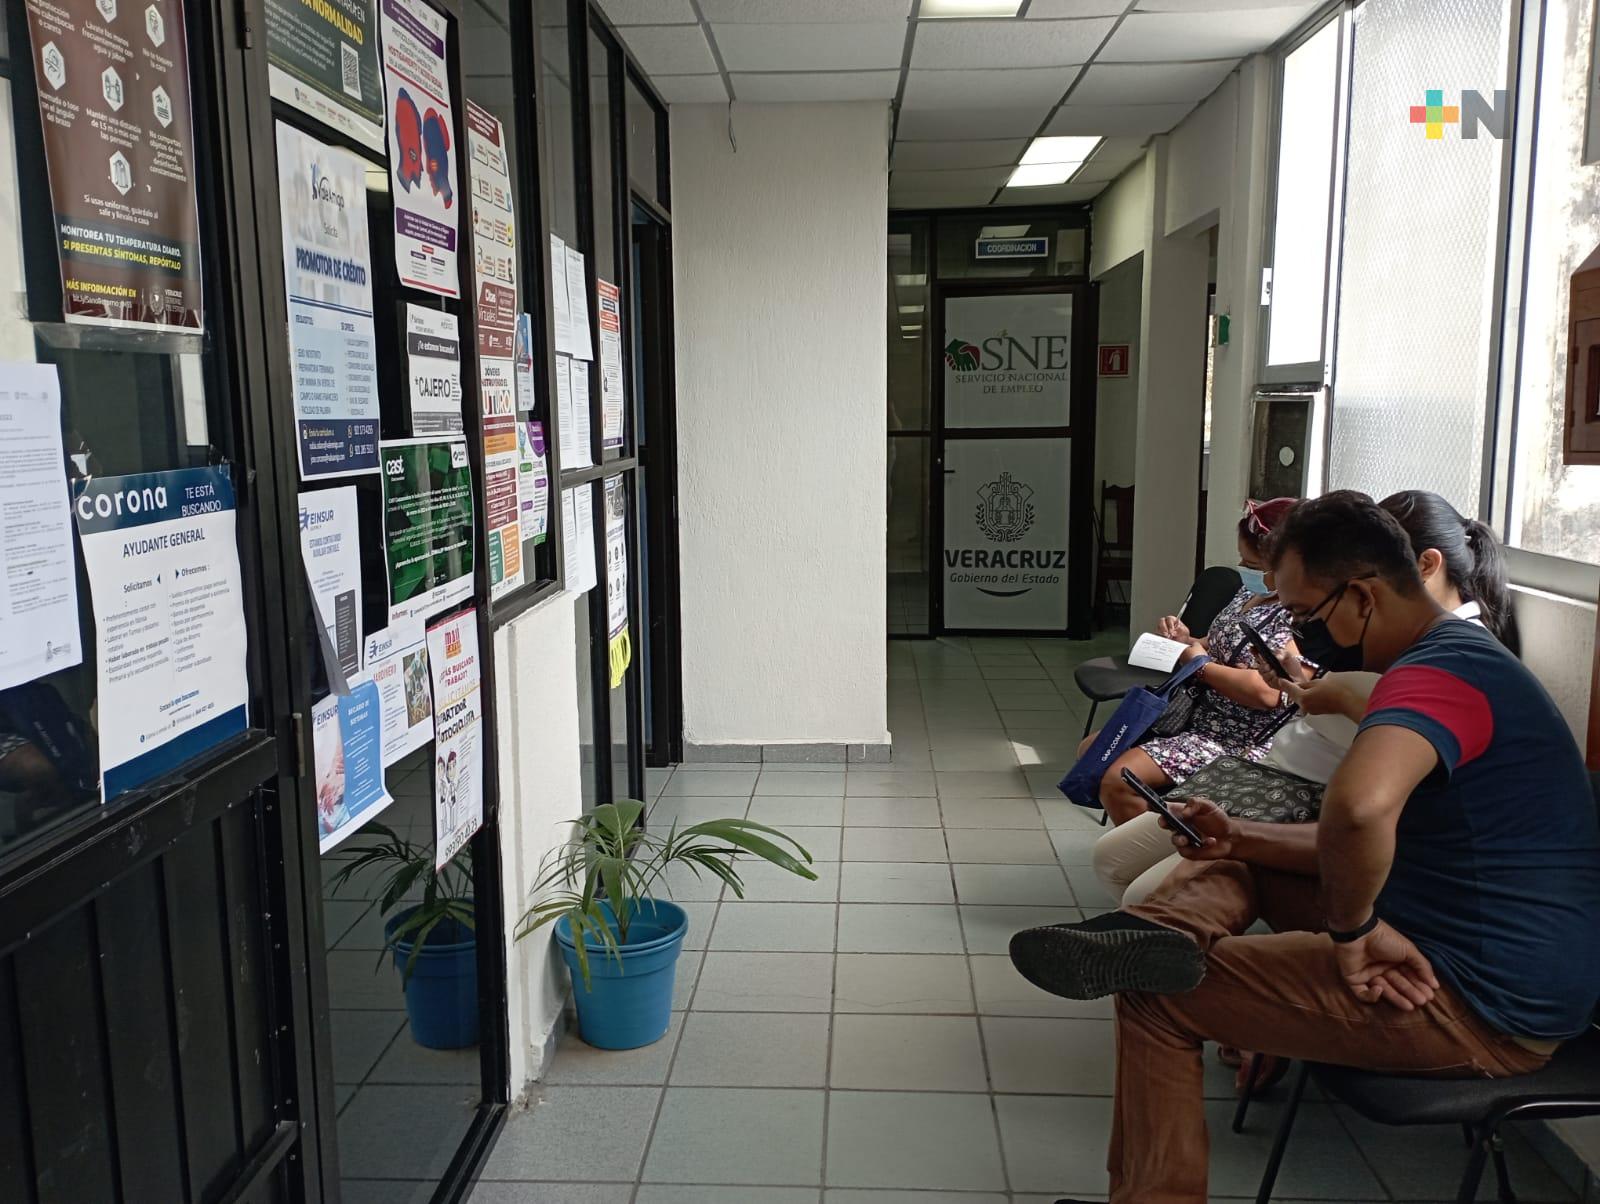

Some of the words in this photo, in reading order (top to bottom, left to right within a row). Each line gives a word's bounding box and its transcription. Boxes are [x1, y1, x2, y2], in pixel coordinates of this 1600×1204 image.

[61, 223, 103, 241] MONITOREA
[105, 232, 115, 244] TU
[116, 235, 161, 254] TEMPERATURA
[987, 243, 1037, 253] COORDINACION
[63, 239, 70, 249] SI
[70, 241, 113, 259] PRESENTAS
[114, 247, 149, 265] SÍNTOMAS,
[149, 256, 181, 271] REPÓRTALO
[295, 247, 333, 278] PROMOTOR
[333, 261, 343, 279] DE
[343, 257, 366, 287] CRÉDITO
[66, 277, 79, 291] MÁS
[80, 280, 128, 298] INFORMACIÓN
[129, 288, 137, 298] EN
[982, 335, 1068, 371] SNE
[955, 373, 1005, 383] SERVICIO
[1008, 372, 1067, 382] NACIONAL
[983, 385, 998, 394] DE
[1000, 384, 1043, 393] EMPLEO
[482, 389, 511, 415] UTURO
[185, 487, 194, 499] TE
[195, 481, 215, 497] ESTÁ
[77, 486, 168, 520] corona
[182, 499, 222, 517] BUSCANDO
[310, 509, 335, 526] EINSUR
[122, 535, 168, 558] AYUDANTE
[169, 527, 206, 547] GENERAL
[944, 549, 1066, 569] VERACRUZ
[181, 565, 206, 577] Ofrecemos
[950, 572, 998, 583] Gobierno
[1001, 573, 1018, 583] del
[1022, 573, 1060, 584] Estado
[123, 579, 152, 594] Solicitamos
[317, 705, 339, 726] EINSUR
